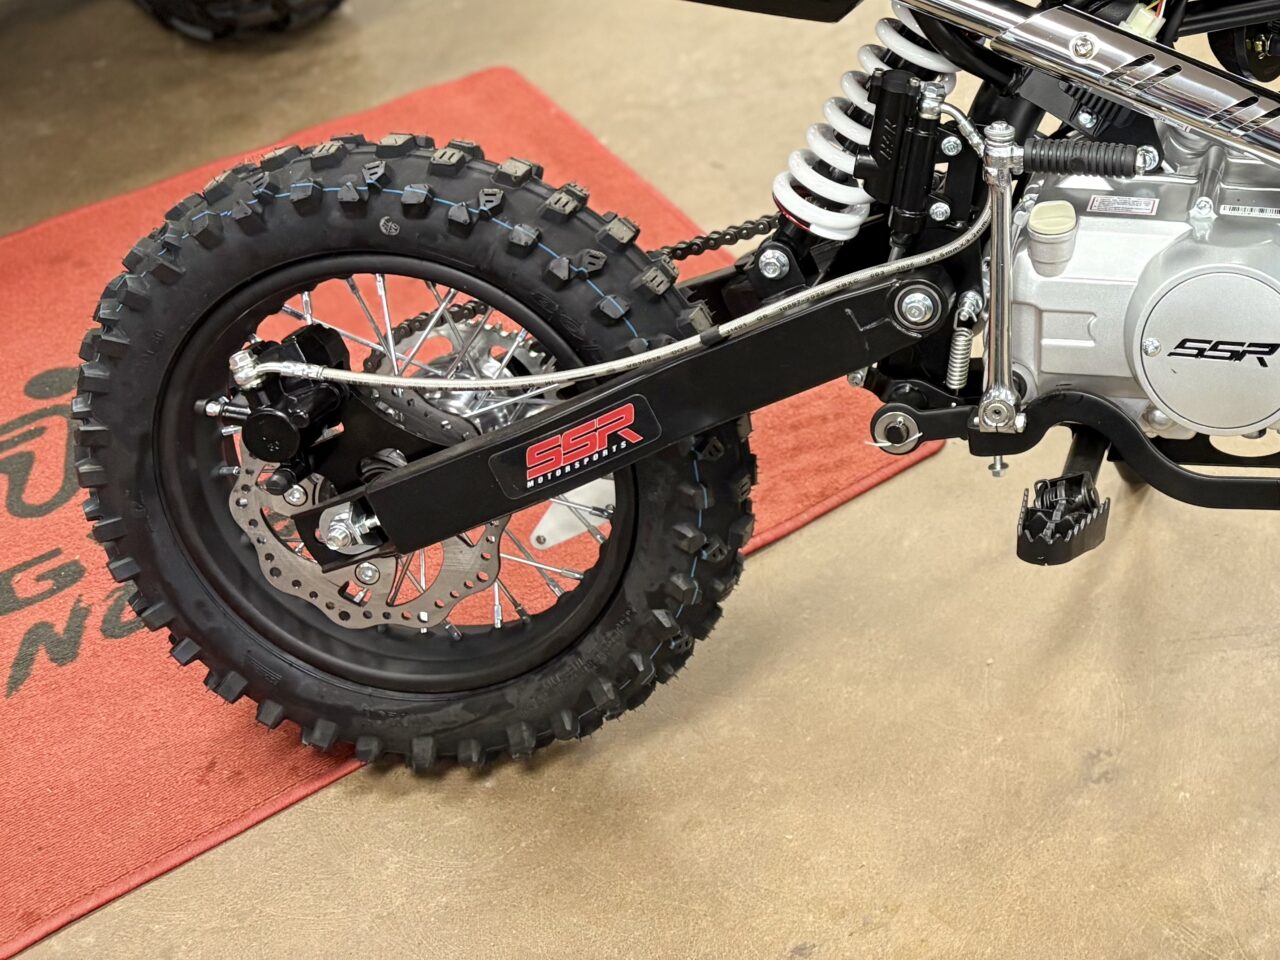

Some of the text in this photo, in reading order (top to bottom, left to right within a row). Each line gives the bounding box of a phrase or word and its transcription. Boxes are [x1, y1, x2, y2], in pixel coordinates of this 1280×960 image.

[1167, 338, 1280, 368] SSR
[526, 403, 643, 481] SSR
[526, 440, 628, 489] MOTORSPORTS
